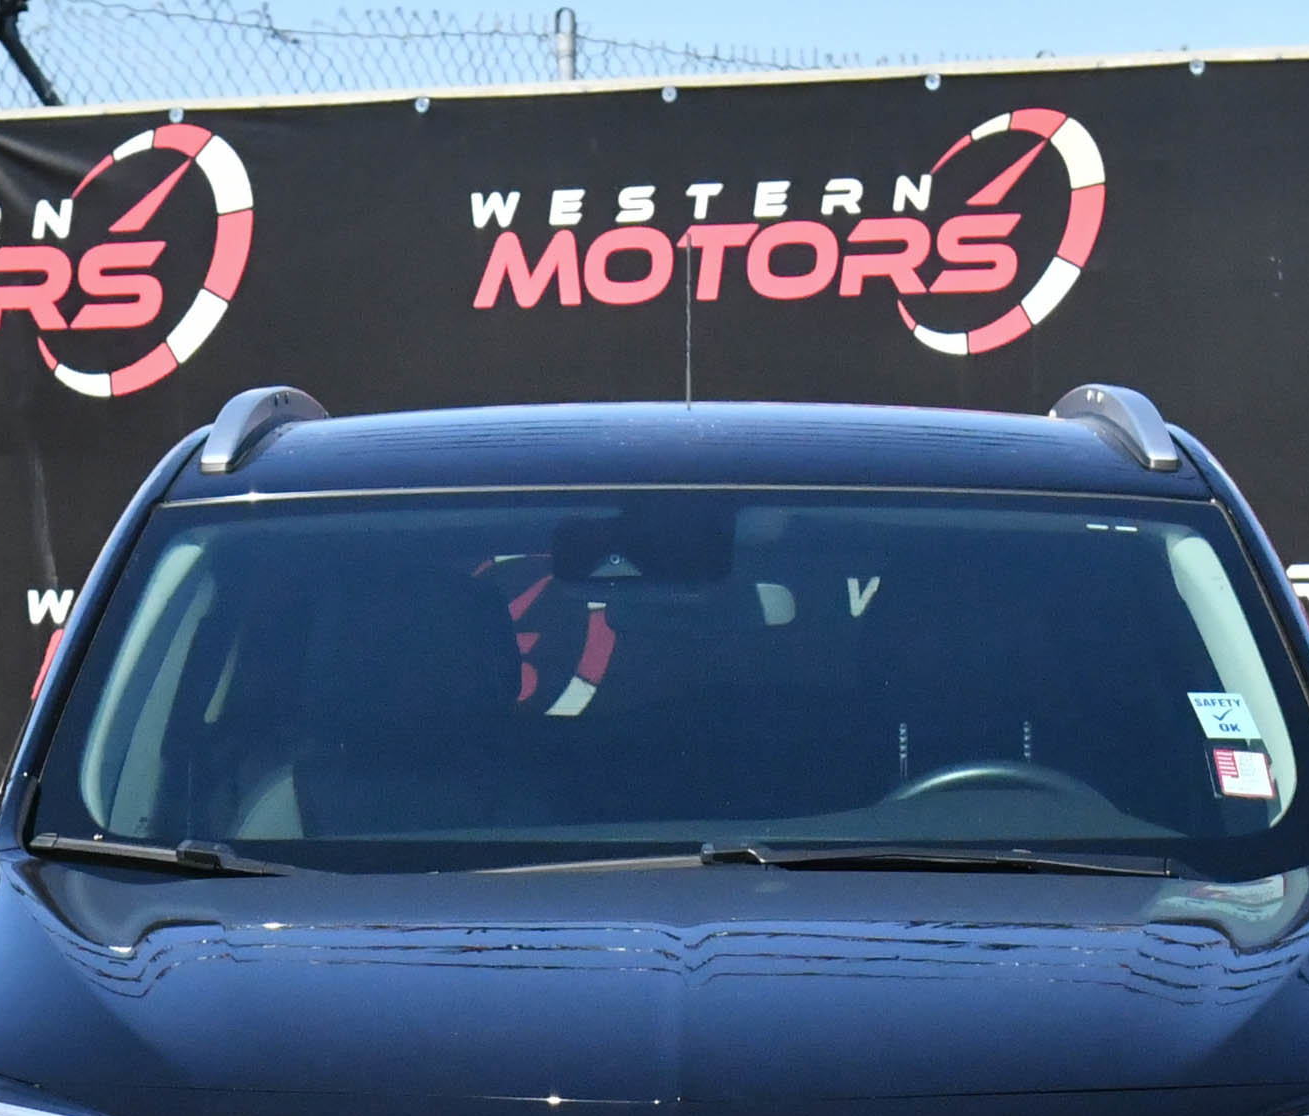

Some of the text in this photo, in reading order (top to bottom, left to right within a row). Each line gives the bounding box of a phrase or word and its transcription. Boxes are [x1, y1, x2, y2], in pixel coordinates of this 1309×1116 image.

[470, 173, 932, 229] WESTERN
[472, 212, 1022, 309] MOTORS
[1194, 698, 1241, 707] SAFETY
[1219, 723, 1241, 732] OK
